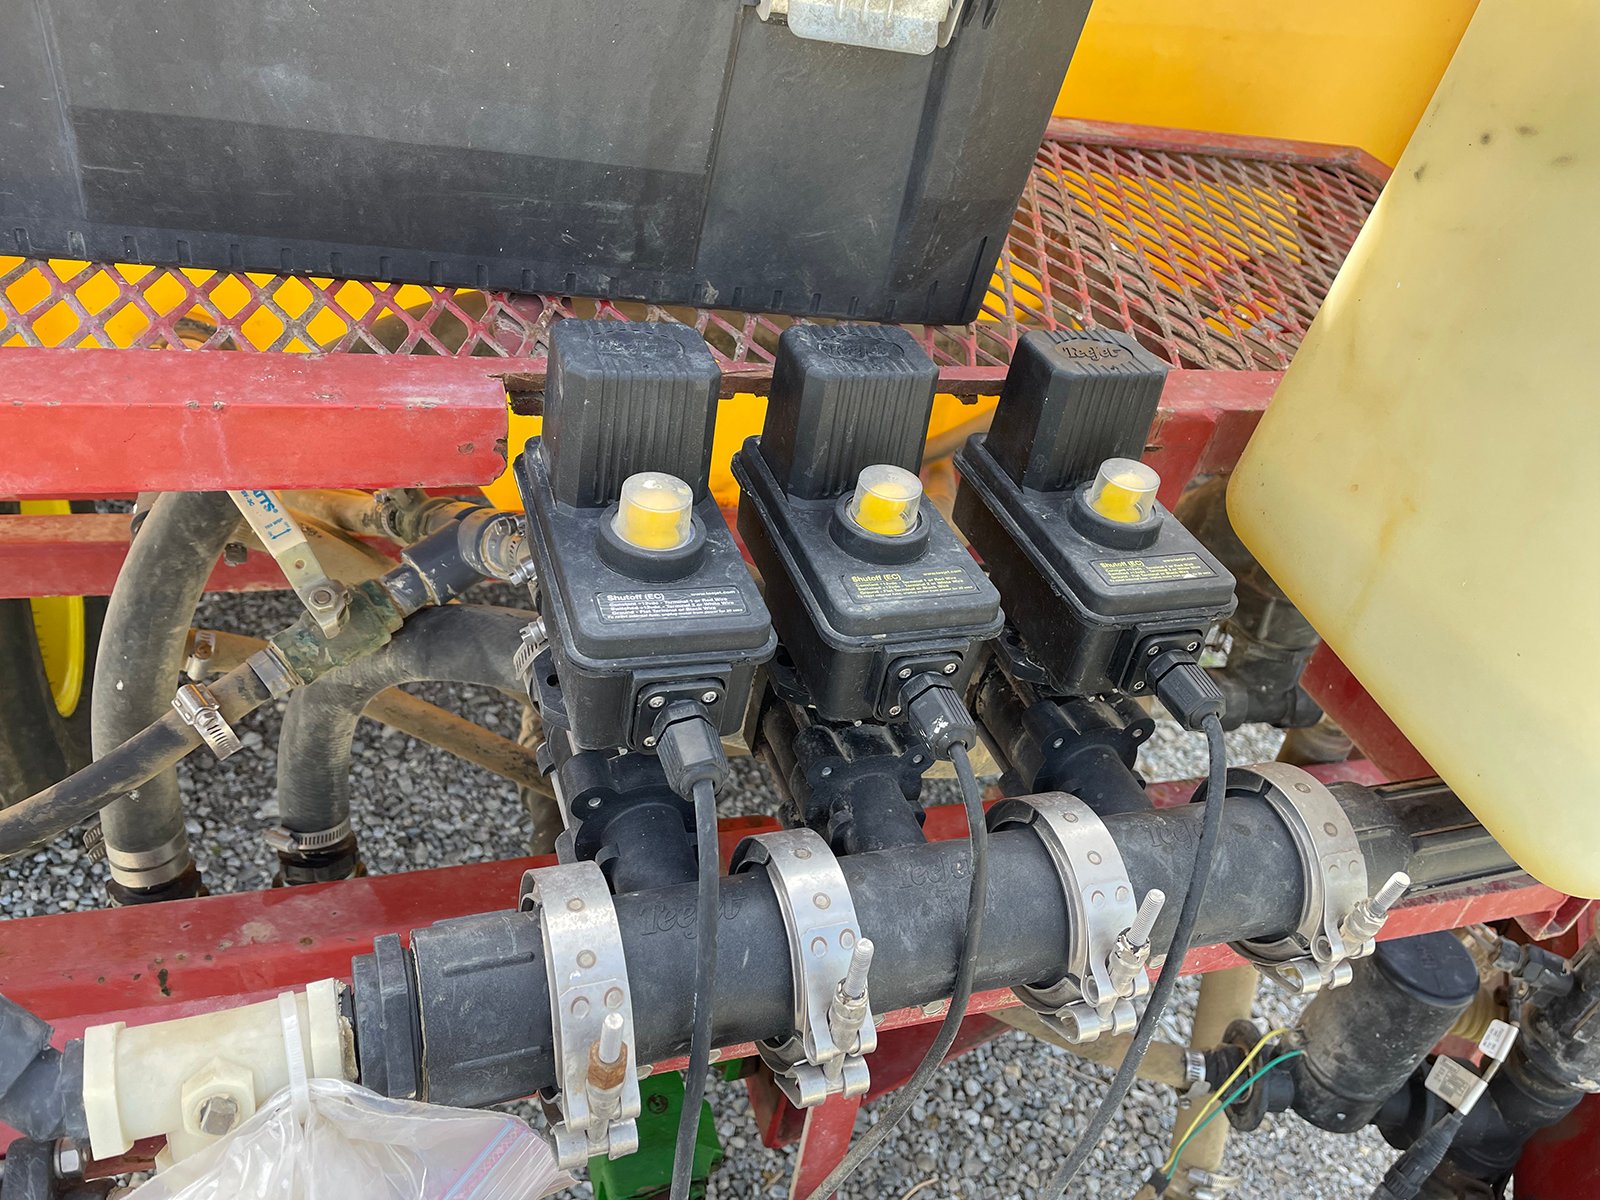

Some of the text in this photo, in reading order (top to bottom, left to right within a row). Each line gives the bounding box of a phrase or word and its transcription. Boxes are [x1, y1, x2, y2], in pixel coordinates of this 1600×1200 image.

[851, 574, 882, 583] Shutoff
[606, 592, 665, 602] Shutoff (EC)
[892, 855, 972, 898] TeeJe
[640, 896, 746, 940] Teet
